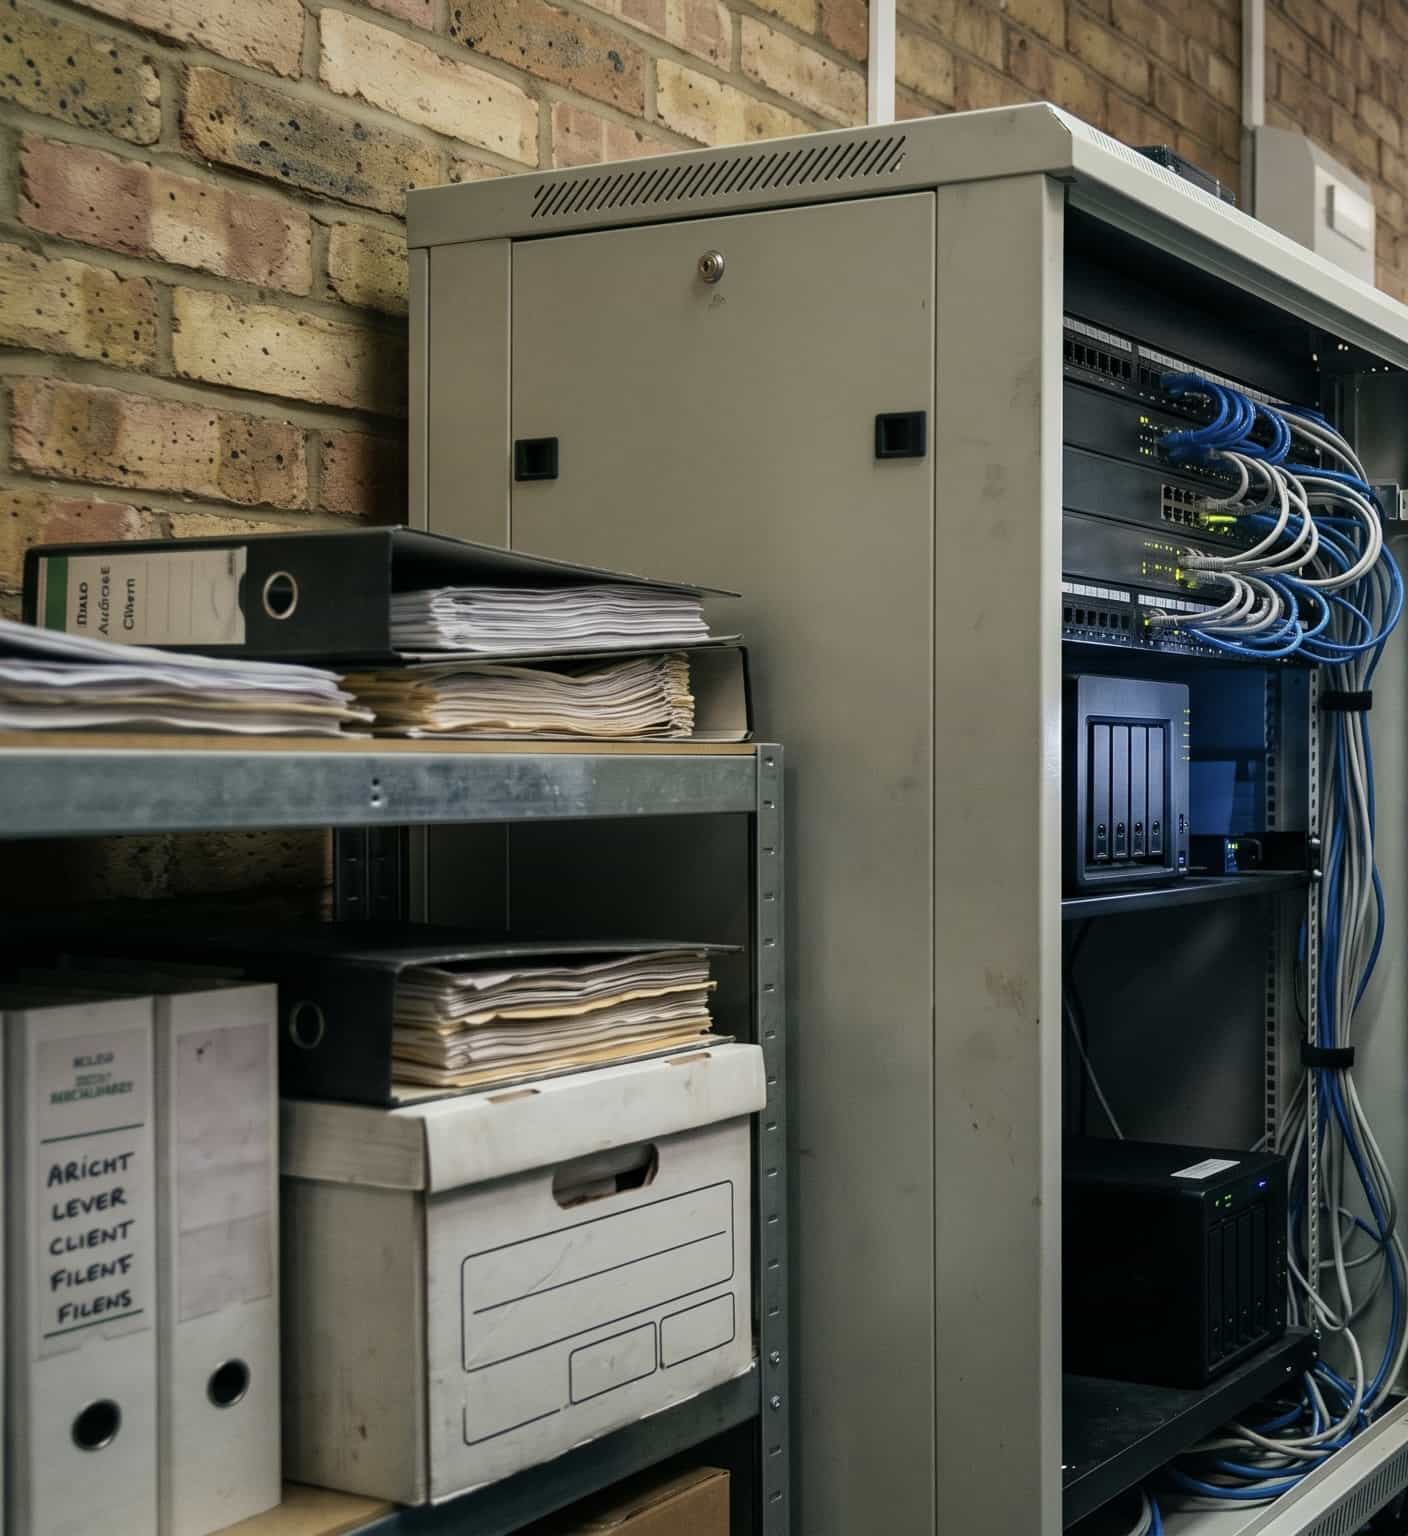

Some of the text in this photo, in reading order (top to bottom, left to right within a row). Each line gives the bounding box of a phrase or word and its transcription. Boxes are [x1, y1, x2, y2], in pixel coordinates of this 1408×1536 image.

[52, 1187, 127, 1221] LEVER
[49, 1219, 135, 1255] CLIENT
[57, 1290, 132, 1324] FILENS
